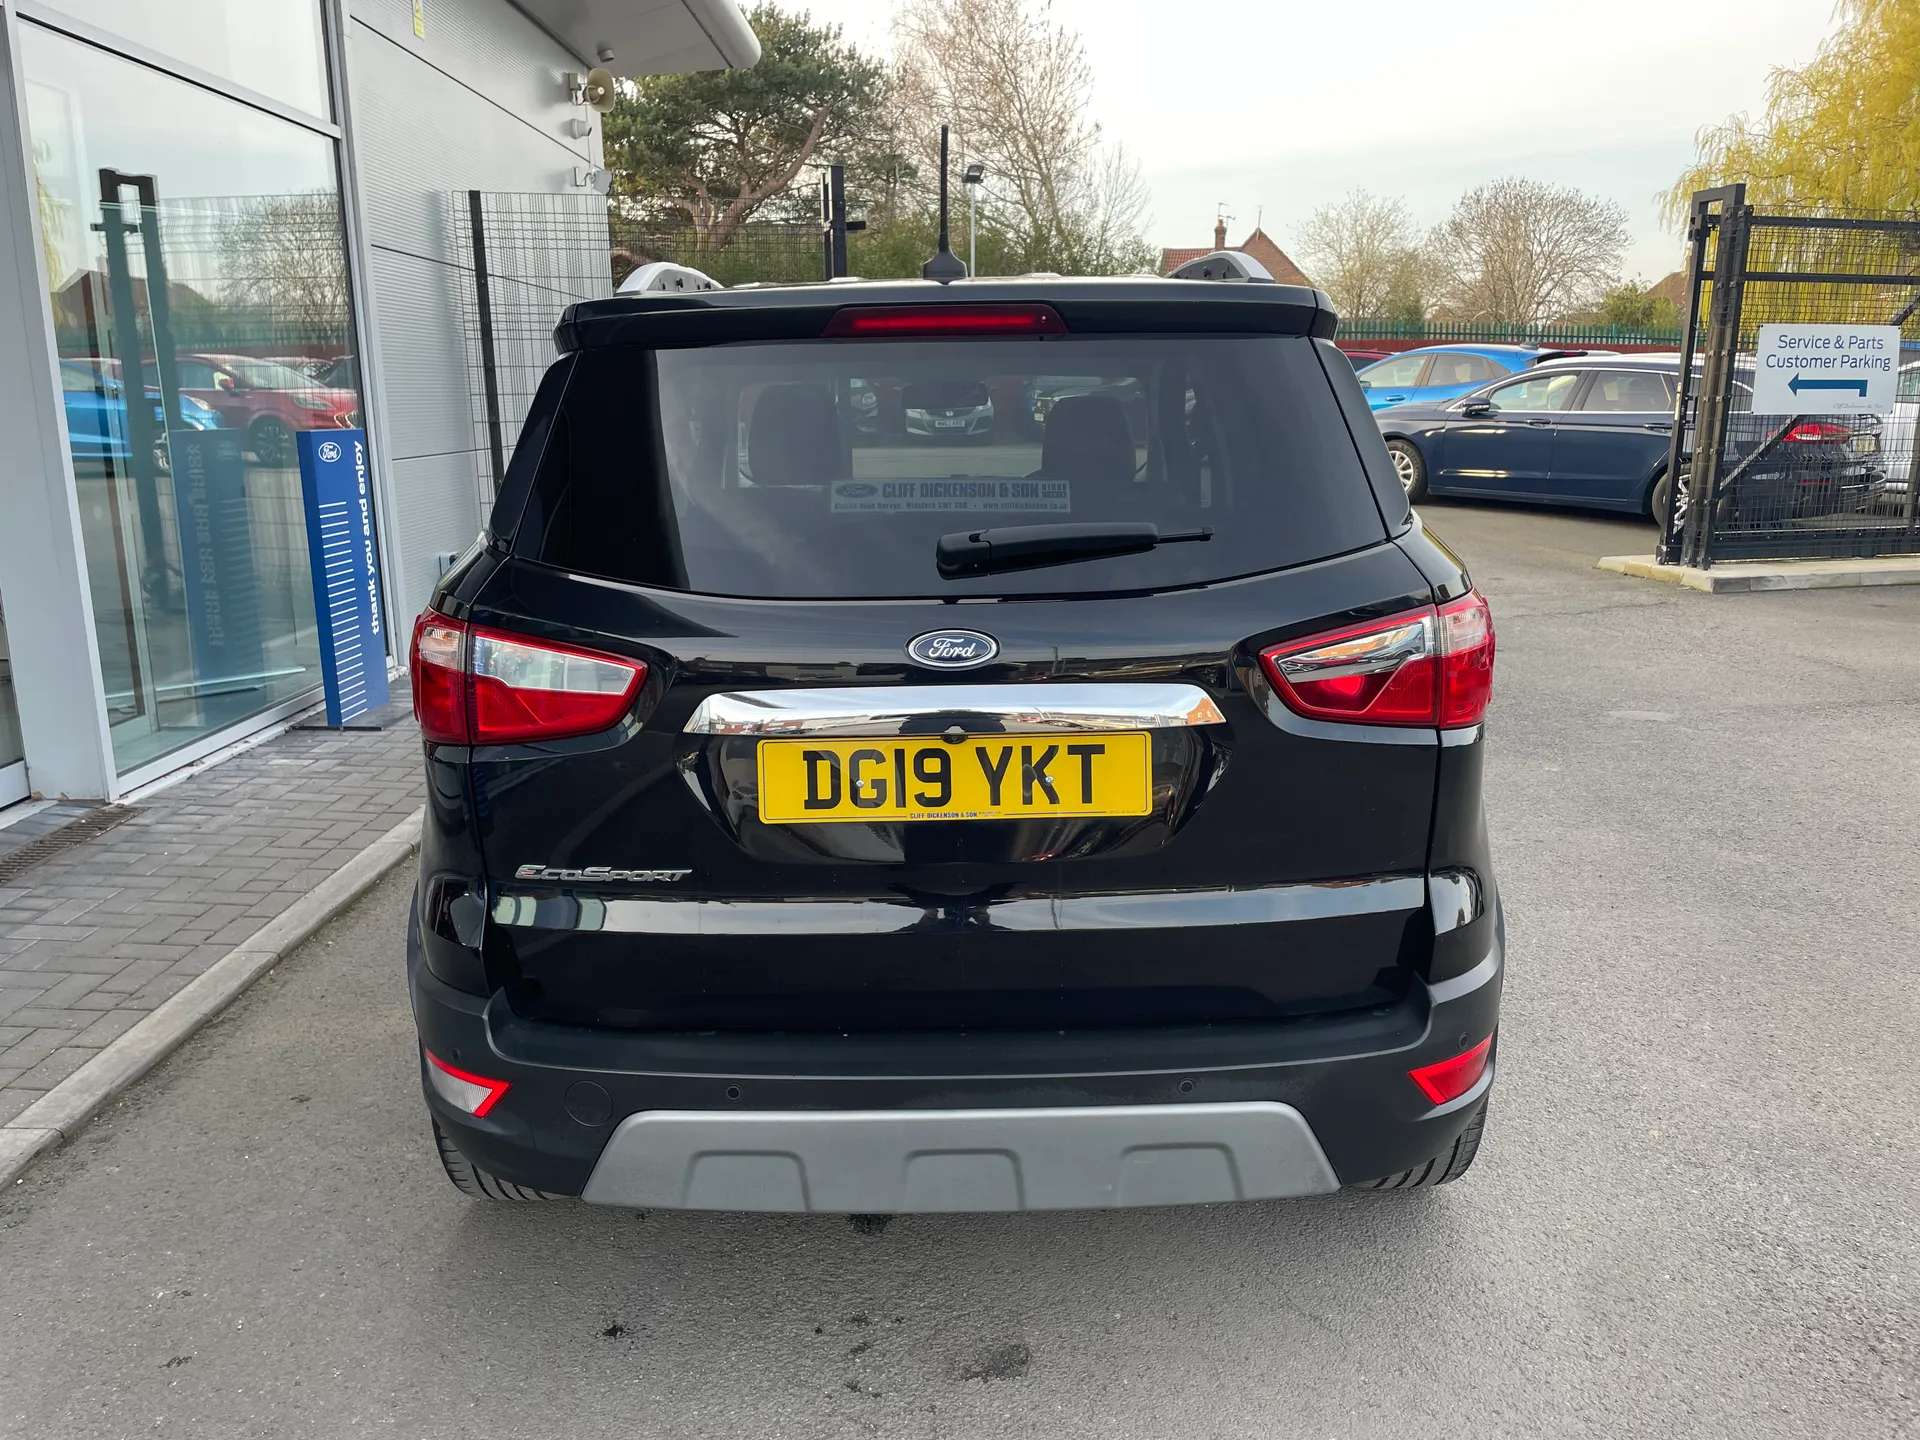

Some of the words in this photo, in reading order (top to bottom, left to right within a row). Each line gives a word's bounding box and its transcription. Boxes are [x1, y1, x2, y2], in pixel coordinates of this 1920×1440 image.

[1777, 334, 1831, 350] Service
[1833, 335, 1845, 350] &
[1849, 335, 1884, 350] Parts
[1766, 353, 1837, 369] Customer
[1840, 354, 1891, 371] Parking
[354, 440, 366, 495] enjoy
[882, 482, 916, 498] CLIFF
[920, 482, 996, 498] DICKENSON
[1011, 482, 1040, 498] SON
[359, 498, 371, 536] and
[365, 540, 376, 576] you
[368, 578, 380, 635] thank
[803, 747, 952, 810] DG19
[975, 743, 1106, 807] YKT
